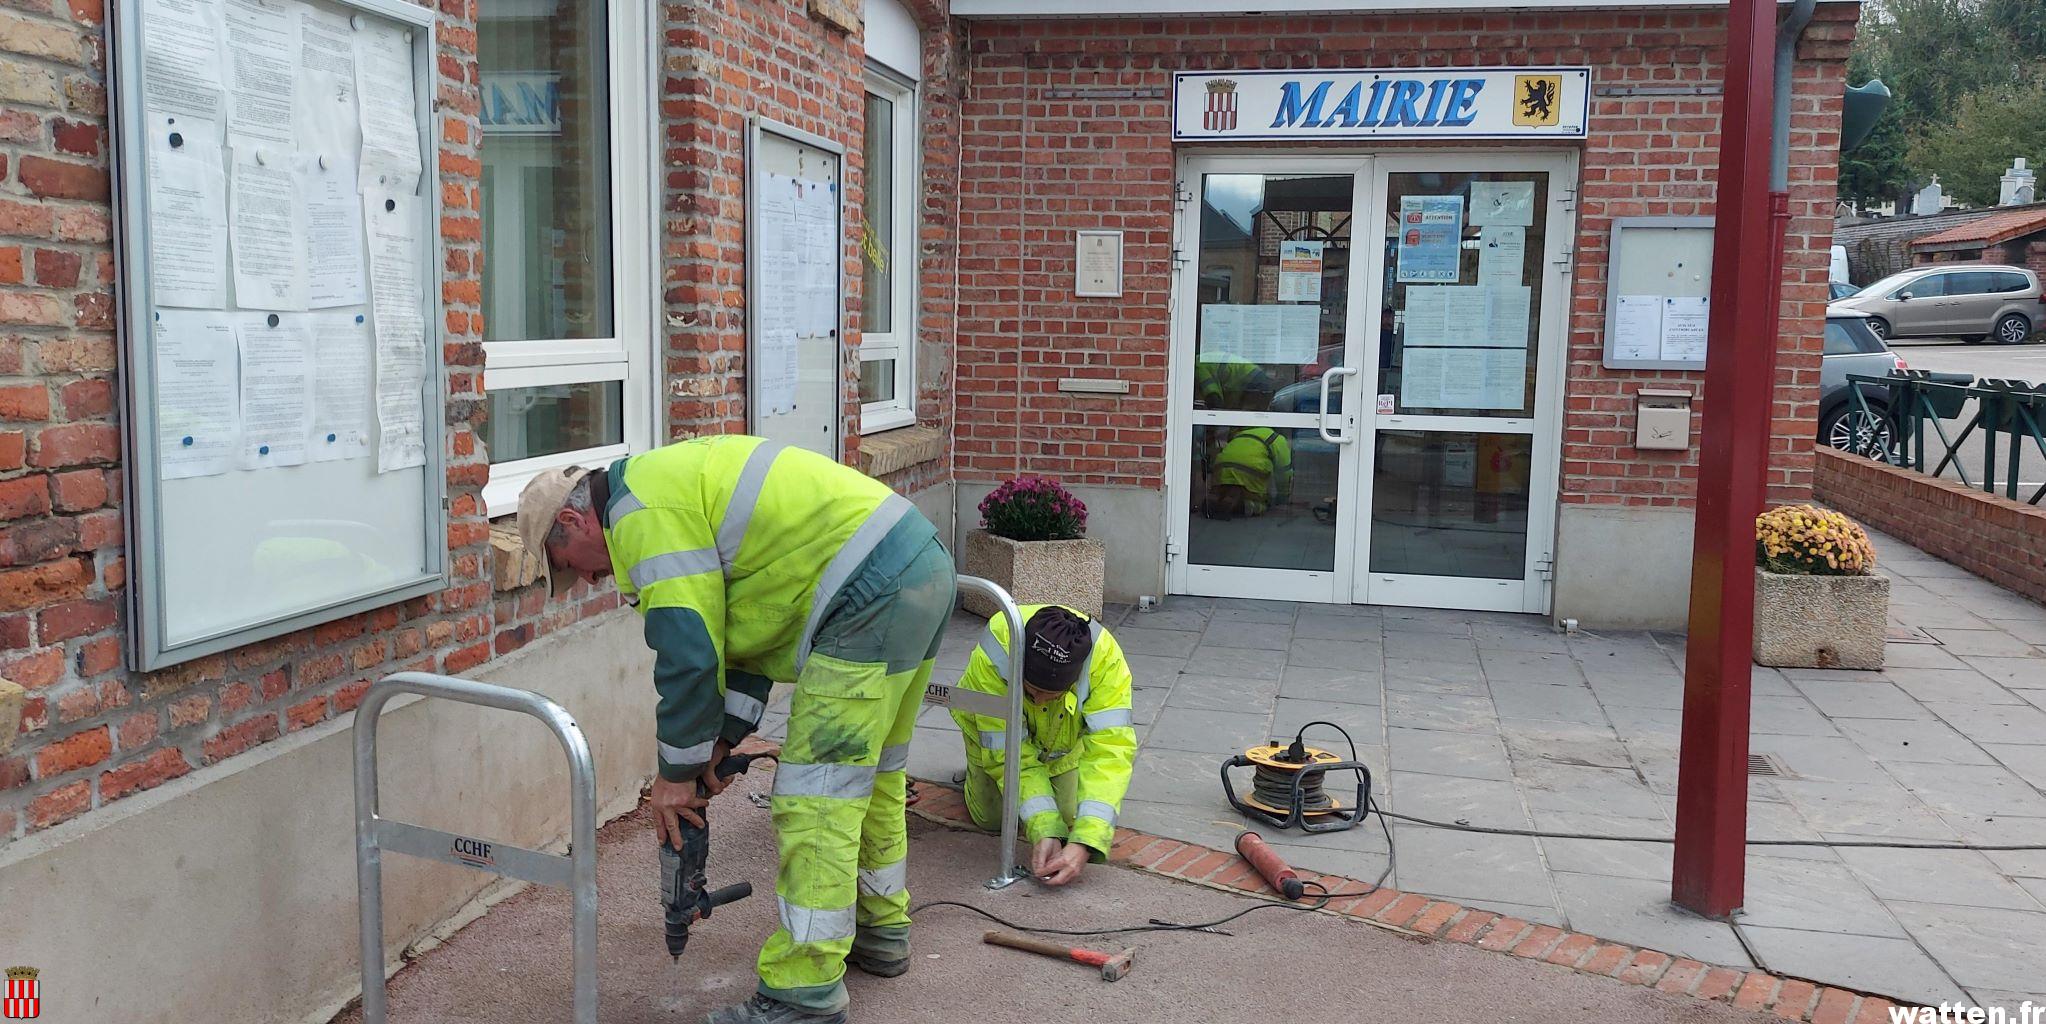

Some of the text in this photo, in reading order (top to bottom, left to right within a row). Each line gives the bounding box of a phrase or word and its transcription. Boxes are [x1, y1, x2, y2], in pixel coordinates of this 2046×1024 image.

[1269, 79, 1487, 128] MAIRIE
[925, 684, 950, 697] CHF
[454, 837, 492, 858] CCHF
